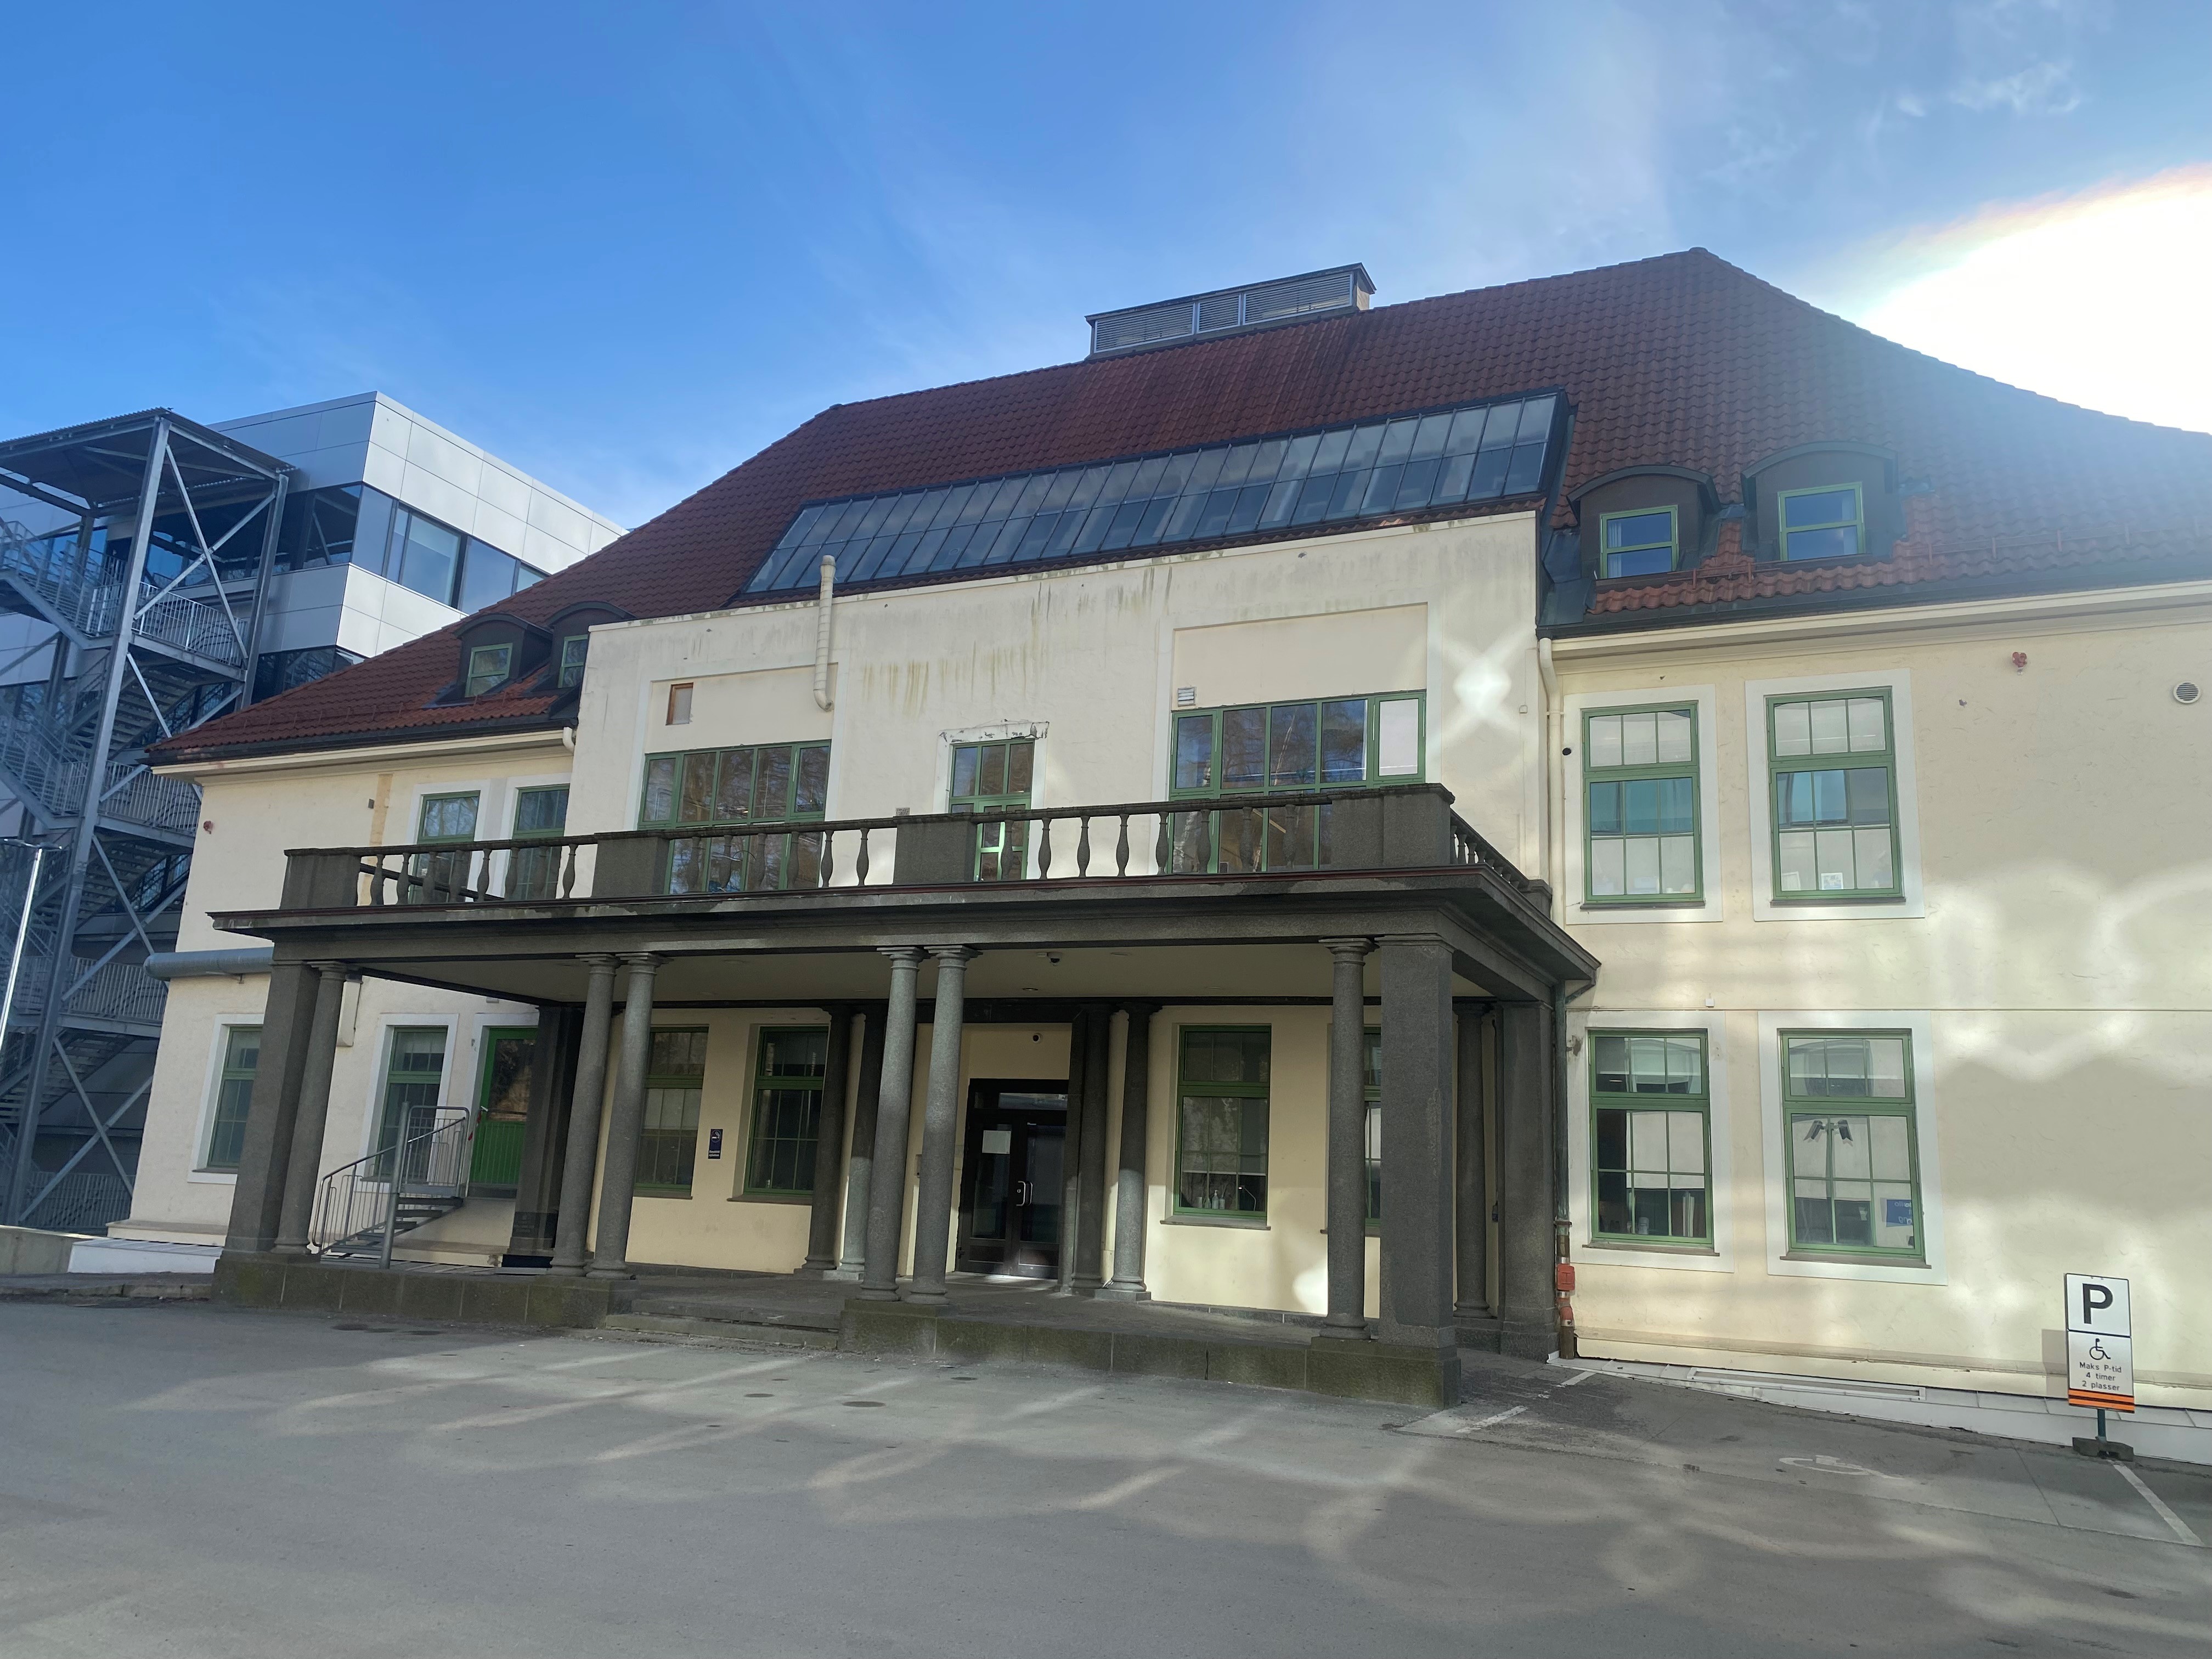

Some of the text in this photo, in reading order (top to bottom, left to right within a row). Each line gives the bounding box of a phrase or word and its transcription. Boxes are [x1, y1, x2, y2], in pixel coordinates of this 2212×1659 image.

[2083, 1283, 2113, 1324] P
[2079, 1362, 2121, 1373] Maks P-tid
[2096, 1373, 2116, 1381] timer
[2091, 1381, 2120, 1391] plasser
